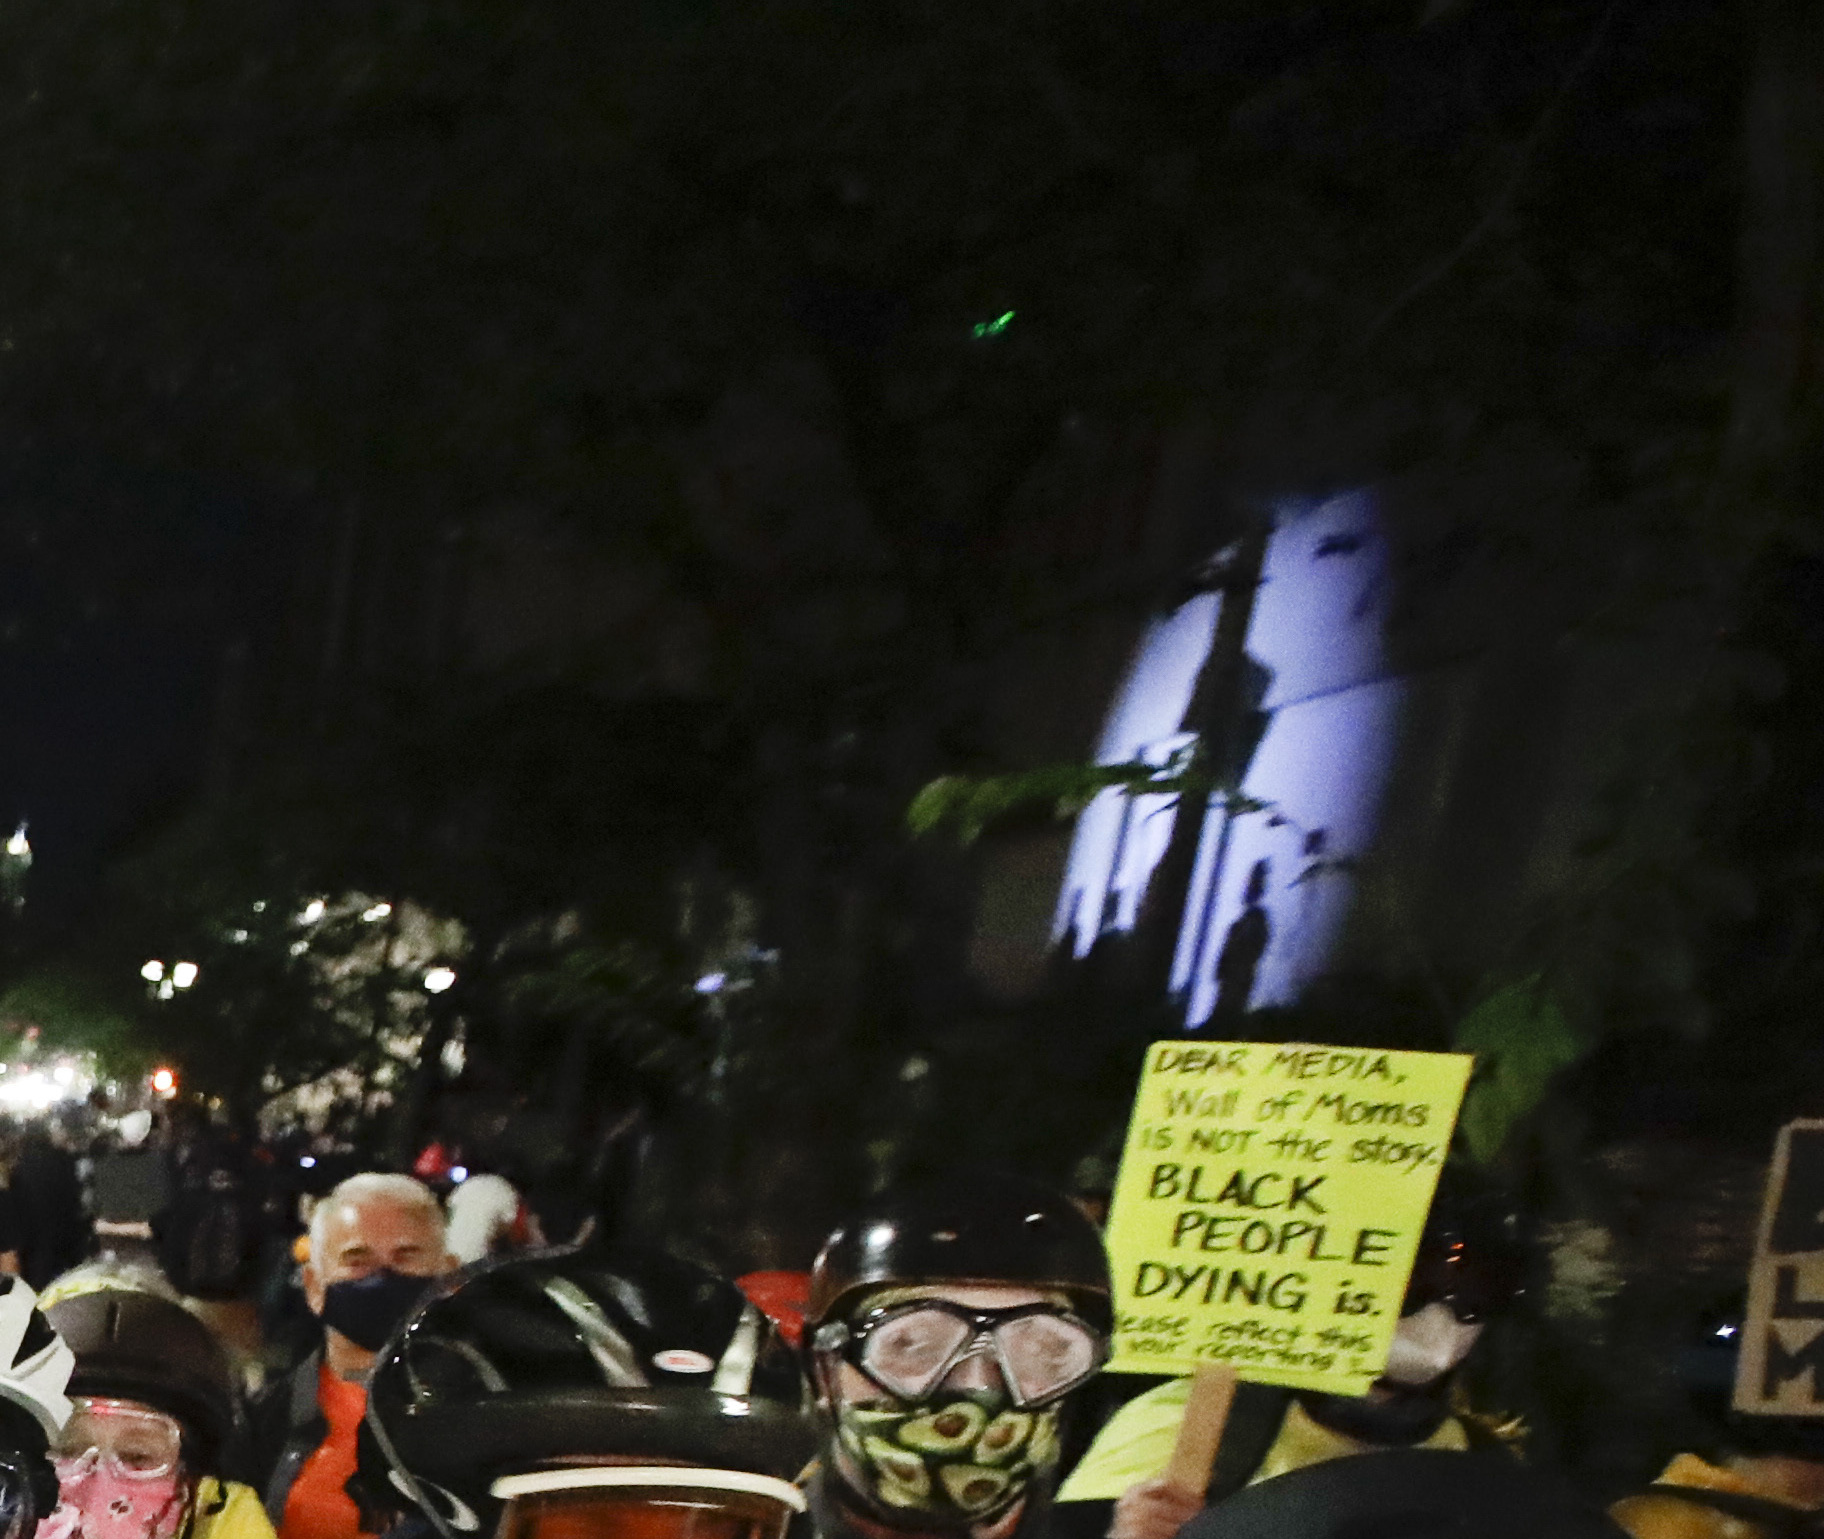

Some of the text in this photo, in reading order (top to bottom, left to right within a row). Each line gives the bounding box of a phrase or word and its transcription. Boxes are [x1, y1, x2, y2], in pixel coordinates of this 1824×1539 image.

[1153, 1049, 1408, 1086] DEAR MEDIA,
[1255, 1089, 1305, 1122] of
[1188, 1127, 1260, 1155] NOT
[1266, 1129, 1333, 1163] the
[1150, 1162, 1328, 1215] BLACK
[1170, 1210, 1399, 1267] PEOPLE
[1132, 1261, 1309, 1314] DYING
